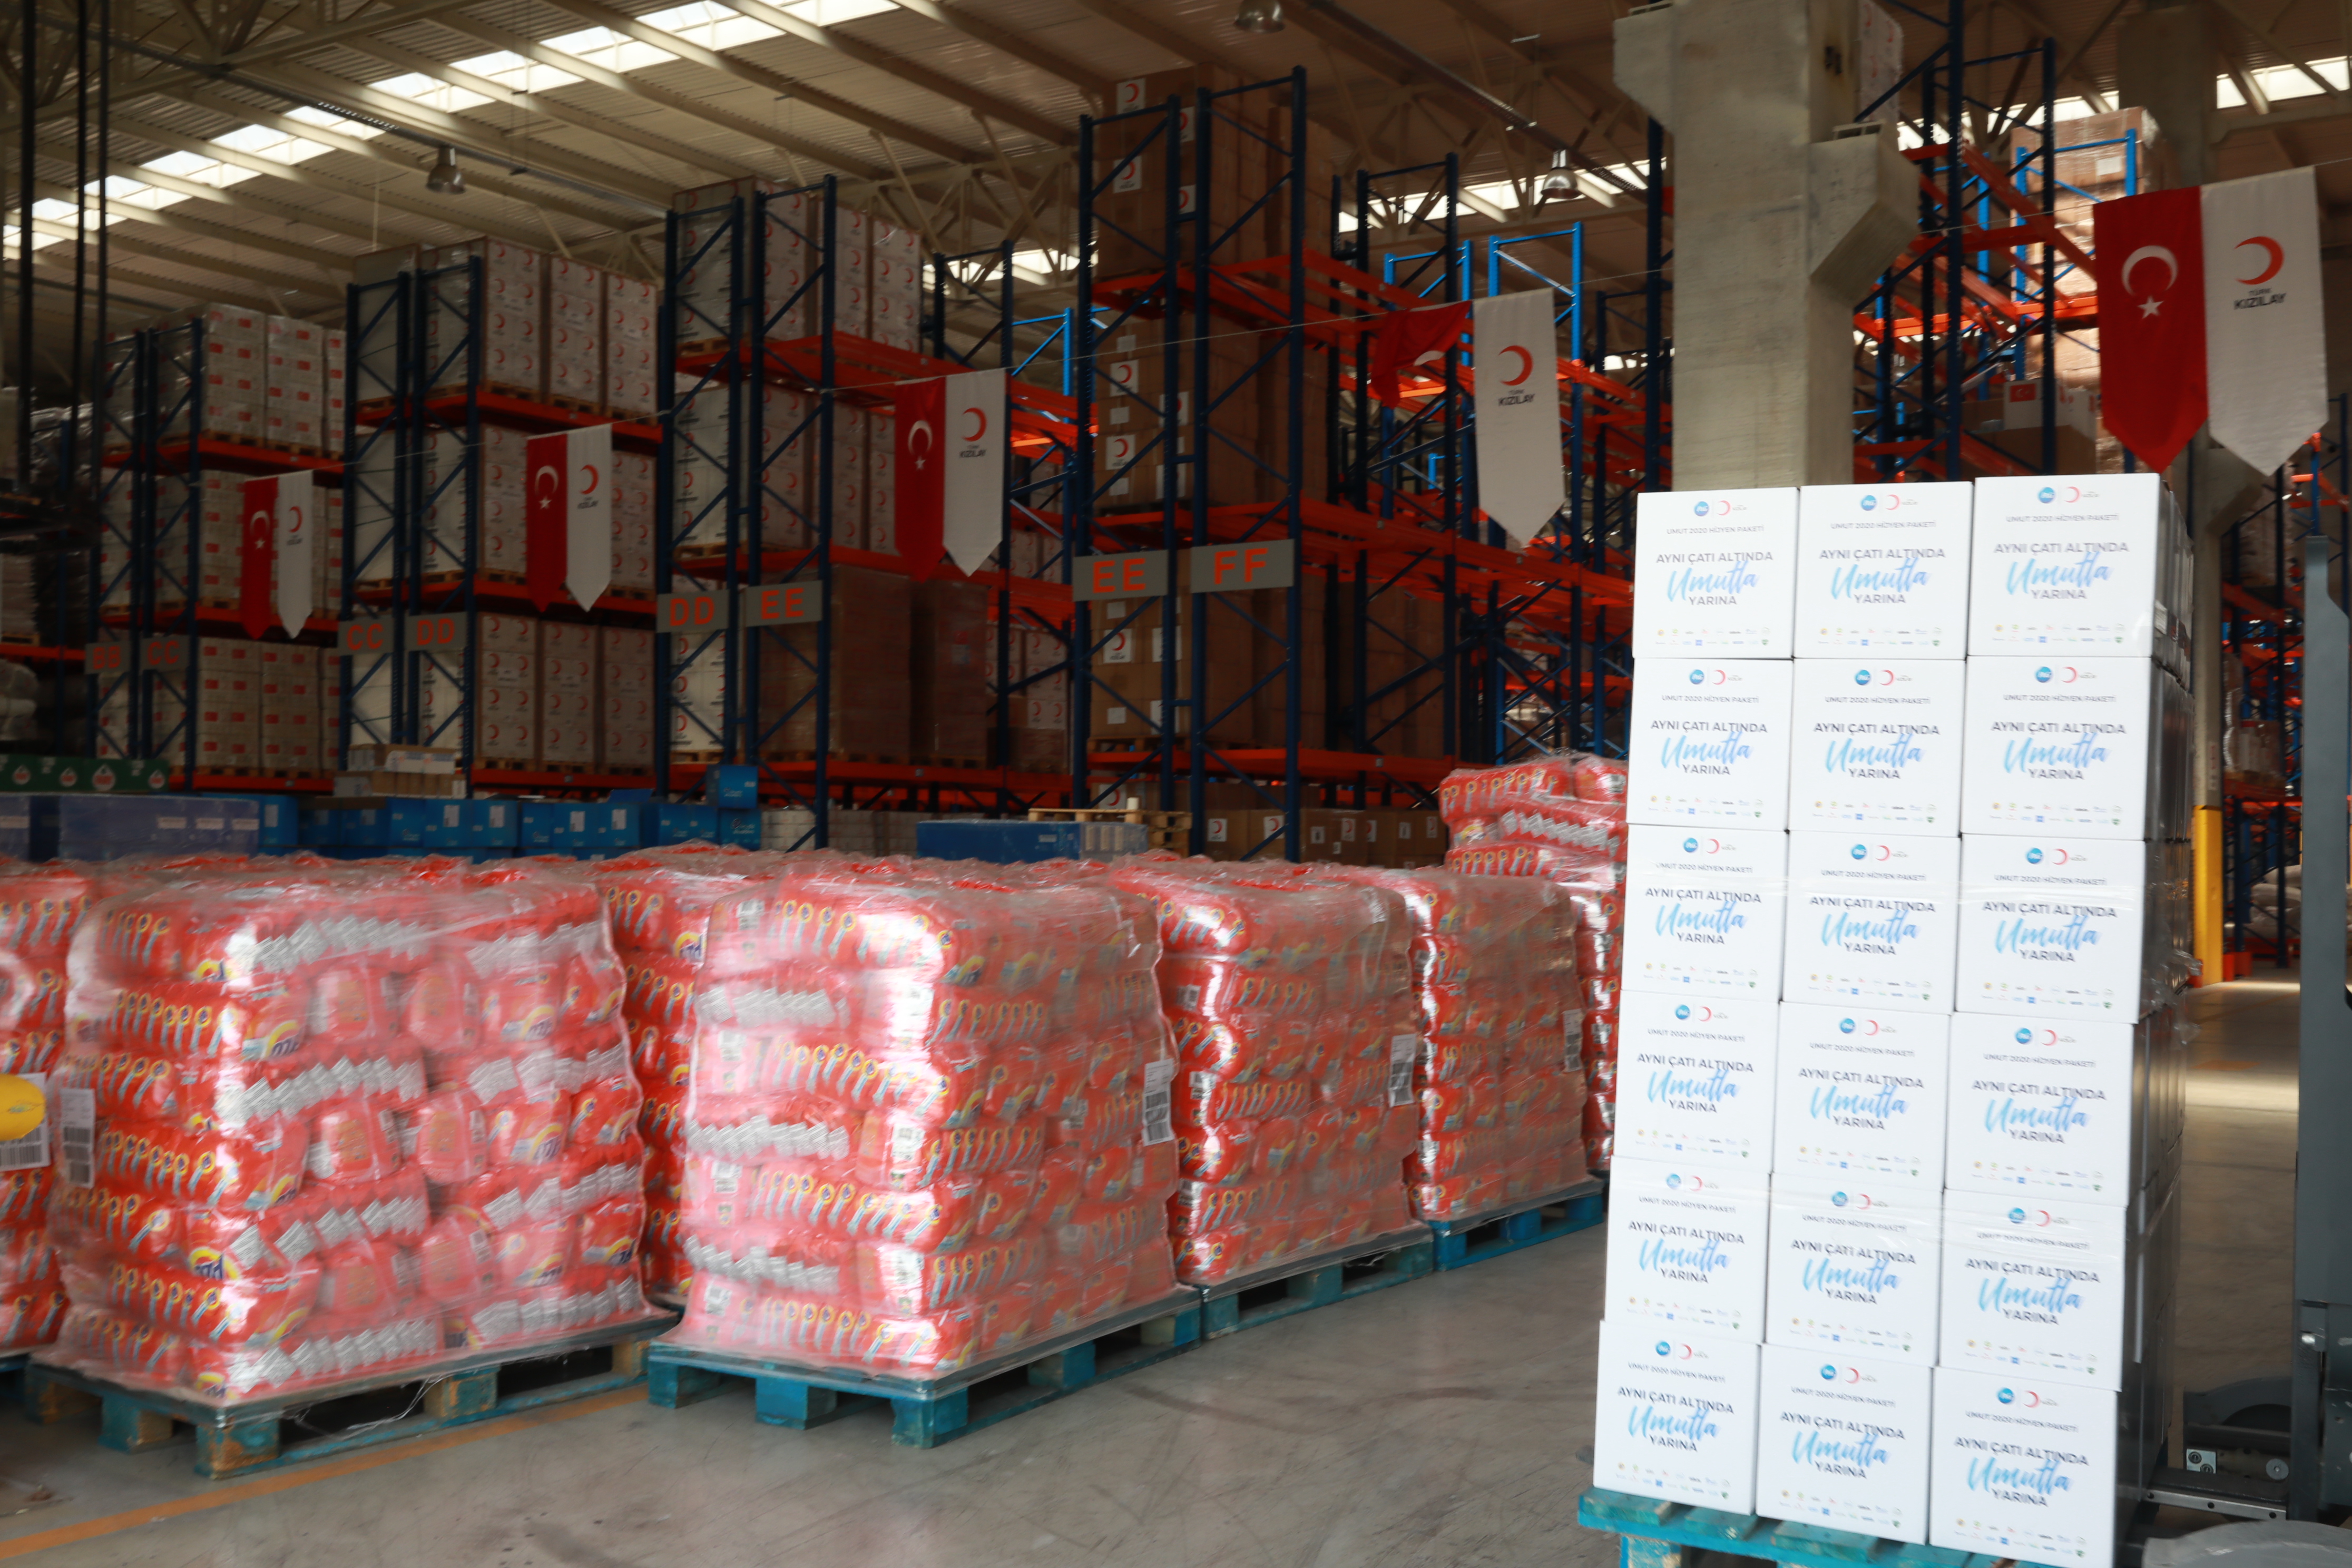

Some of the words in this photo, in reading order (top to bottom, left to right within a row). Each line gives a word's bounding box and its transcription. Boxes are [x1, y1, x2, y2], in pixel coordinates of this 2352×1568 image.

[2234, 293, 2286, 310] KIZILAY
[1498, 394, 1535, 406] KIZILAY
[1657, 554, 1684, 563] AYNI
[1688, 553, 1715, 565] ÇATI
[1718, 552, 1774, 562] ALTINDA
[1819, 550, 1850, 558] AYNI
[1854, 549, 1883, 562] ÇATI
[1886, 548, 1946, 558] ALTINDA
[1994, 544, 2026, 553] AYNI
[2031, 543, 2062, 556] ÇATI
[2065, 542, 2129, 552] ALTINDA
[1092, 558, 1146, 594] EE
[1214, 547, 1269, 585] FF
[2006, 551, 2112, 595] Umutla
[1667, 560, 1759, 602] Umutla
[1831, 557, 1930, 600] Umutla
[760, 587, 805, 620] EE
[1688, 595, 1737, 605] YARINA
[1854, 594, 1906, 604] YARINA
[2031, 589, 2087, 599] YARINA
[669, 596, 715, 626] DD
[346, 623, 384, 651] CC
[416, 618, 455, 646] DD
[93, 646, 121, 670] BB
[148, 641, 179, 665] CC
[1651, 720, 1679, 730] AYNI
[1682, 721, 1709, 733] ÇATI
[1712, 722, 1768, 732] ALTINDA
[1814, 723, 1844, 732] AYNI
[1848, 723, 1877, 736] ÇATI
[1880, 724, 1941, 734] ALTINDA
[1992, 722, 2024, 732] AYNI
[2028, 722, 2059, 735] ÇATI
[2062, 723, 2126, 734] ALTINDA
[1661, 731, 1753, 768] Umutla
[1825, 733, 1925, 773] Umutla
[2004, 732, 2110, 773] Umutla
[1682, 765, 1731, 775] YARINA
[1848, 769, 1901, 779] YARINA
[2028, 769, 2084, 780] YARINA
[1645, 888, 1673, 898] AYNI
[1677, 889, 1703, 901] ÇATI
[1707, 891, 1762, 903] ALTINDA
[1810, 896, 1840, 906] AYNI
[1844, 898, 1873, 910] ÇATI
[1876, 900, 1936, 912] ALTINDA
[1655, 900, 1747, 936] Umutla
[1983, 901, 2015, 912] AYNI
[2019, 903, 2050, 916] ÇATI
[2053, 905, 2118, 917] ALTINDA
[1821, 909, 1920, 946] Umutla
[1995, 915, 2101, 954] Umutla
[1677, 933, 1725, 944] YARINA
[1844, 943, 1896, 955] YARINA
[2020, 949, 2075, 962] YARINA
[1637, 1054, 1665, 1064] AYNI
[1669, 1056, 1696, 1068] ÇATI
[1699, 1059, 1755, 1072] ALTINDA
[1647, 1069, 1739, 1103] Umutla
[1799, 1068, 1829, 1080] AYNI
[1832, 1071, 1861, 1083] ÇATI
[1865, 1074, 1925, 1088] ALTINDA
[1972, 1080, 2004, 1092] AYNI
[2008, 1083, 2039, 1095] ÇATI
[2043, 1086, 2106, 1100] ALTINDA
[1669, 1100, 1717, 1113] YARINA
[1810, 1084, 1909, 1119] Umutla
[1833, 1116, 1885, 1130] YARINA
[1985, 1096, 2090, 1133] Umutla
[2009, 1129, 2065, 1143] YARINA
[1629, 1221, 1656, 1233] AYNI
[1660, 1224, 1687, 1237] ÇATI
[1690, 1229, 1745, 1244] ALTINDA
[1639, 1239, 1730, 1272] Umutla
[1791, 1240, 1821, 1252] AYNI
[1825, 1244, 1854, 1257] ÇATI
[1857, 1248, 1916, 1264] ALTINDA
[1660, 1268, 1709, 1283] YARINA
[1802, 1258, 1900, 1293] Umutla
[1966, 1258, 1998, 1271] AYNI
[2002, 1262, 2033, 1276] ÇATI
[2036, 1267, 2100, 1282] ALTINDA
[1825, 1288, 1877, 1304] YARINA
[1978, 1277, 2084, 1313] Umutla
[2003, 1309, 2059, 1325] YARINA
[1618, 1387, 1645, 1399] AYNI
[1649, 1391, 1676, 1405] ÇATI
[1679, 1397, 1734, 1414] ALTINDA
[1628, 1405, 1720, 1440] Umutla
[1780, 1412, 1810, 1425] AYNI
[1814, 1417, 1843, 1430] ÇATI
[1846, 1422, 1906, 1439] ALTINDA
[1649, 1435, 1698, 1452] YARINA
[1792, 1431, 1890, 1467] Umutla
[1955, 1437, 1987, 1451] AYNI
[1991, 1442, 2022, 1456] ÇATI
[2025, 1448, 2089, 1466] ALTINDA
[1815, 1461, 1867, 1478] YARINA
[1967, 1457, 2073, 1495] Umutla
[1992, 1488, 2048, 1506] YARINA
